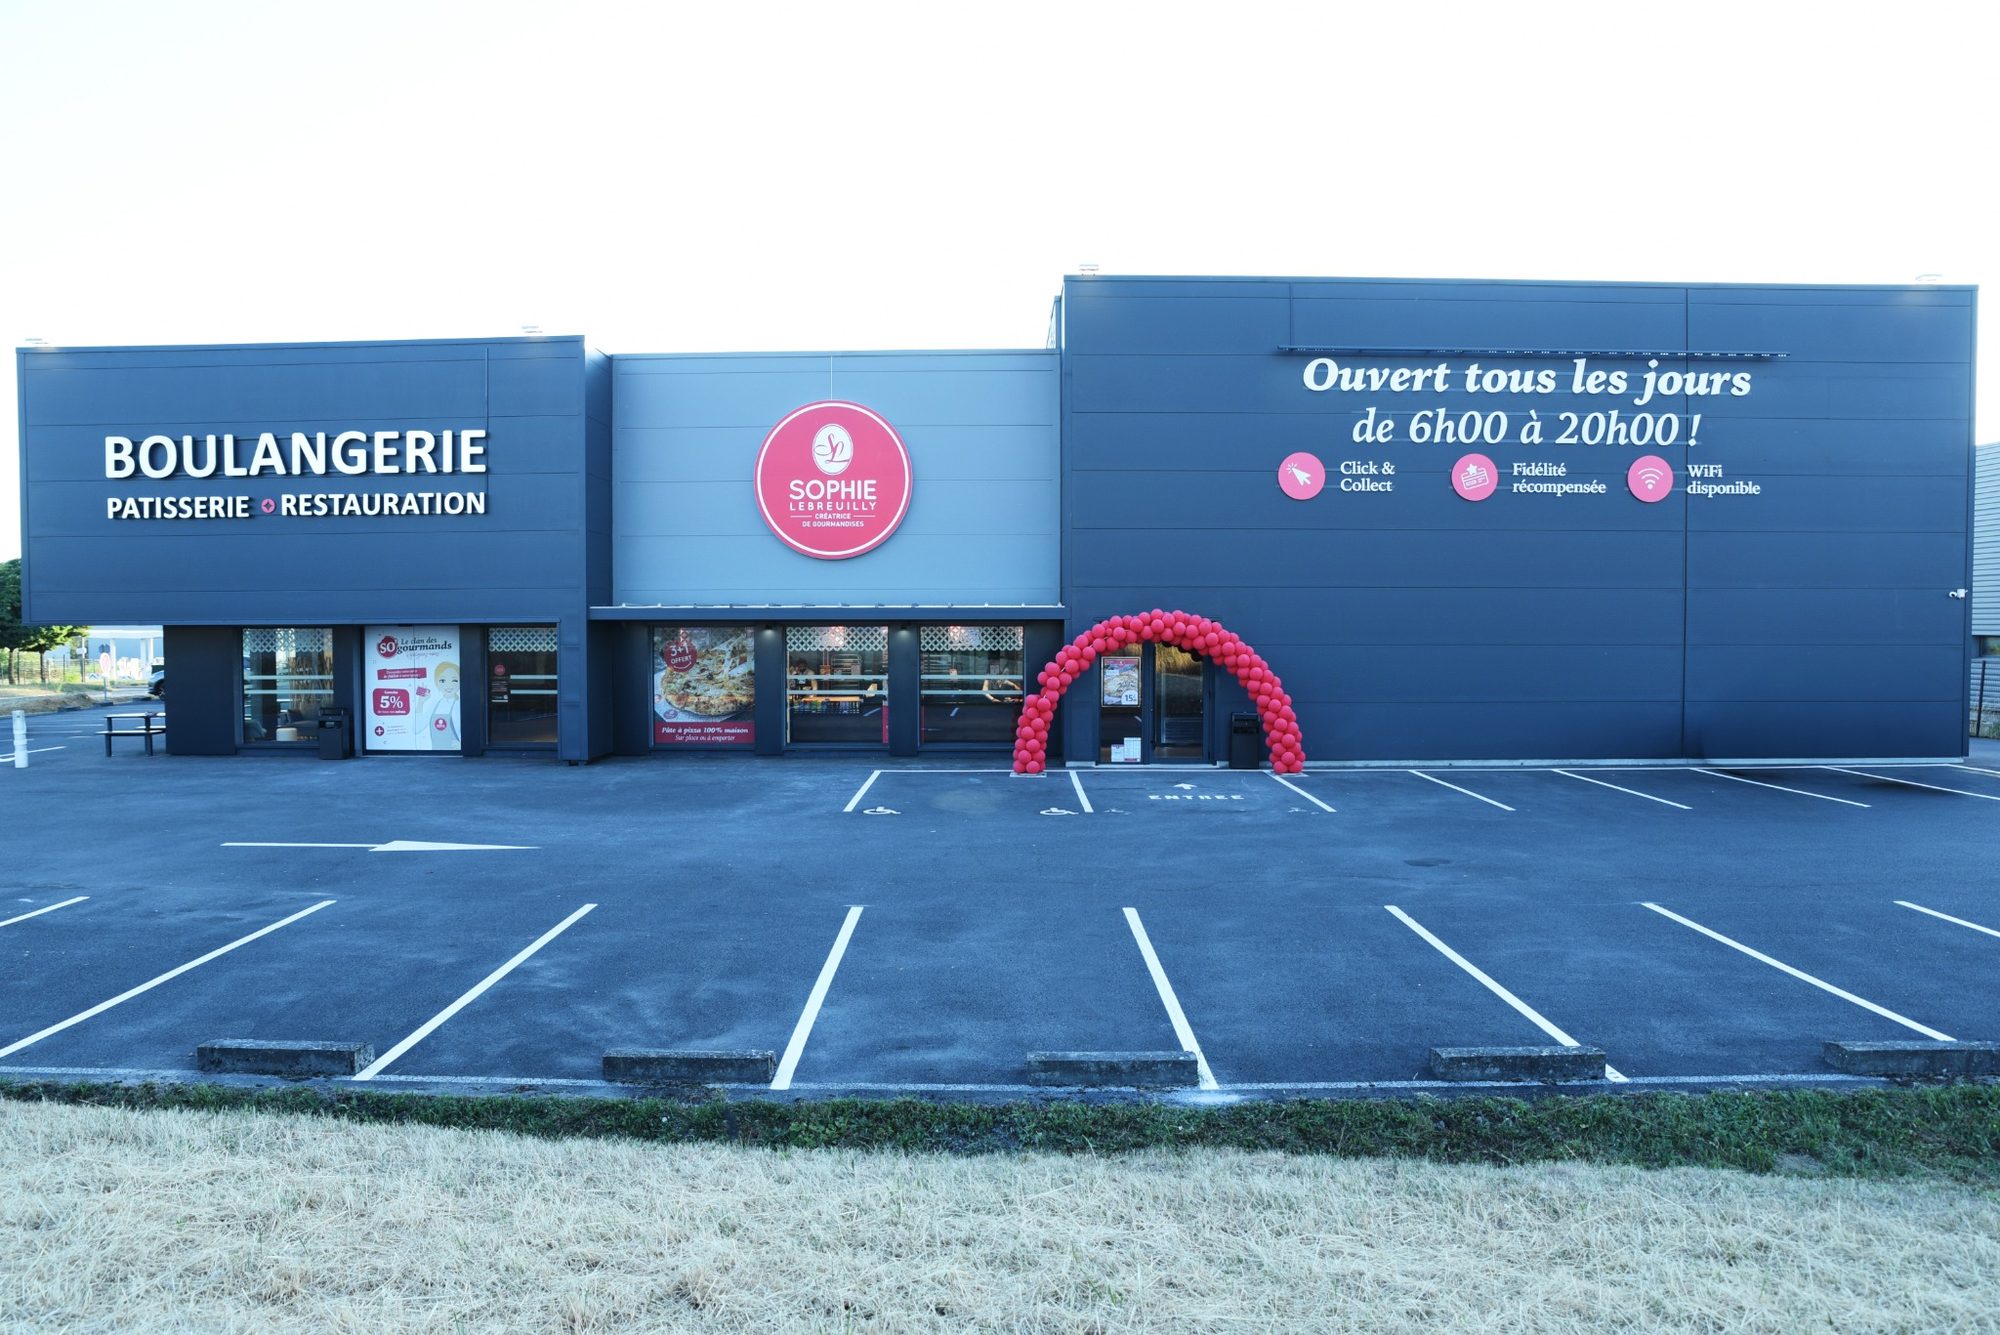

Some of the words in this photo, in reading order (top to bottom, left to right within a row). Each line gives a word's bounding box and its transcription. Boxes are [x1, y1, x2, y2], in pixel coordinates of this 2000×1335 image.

[1303, 357, 1450, 392] Ouvert
[1465, 363, 1556, 393] tous
[1572, 358, 1628, 394] les
[1634, 359, 1751, 406] jours
[1352, 407, 1394, 443] de
[1409, 408, 1508, 444] 6h00
[1520, 409, 1543, 445] à
[1555, 410, 1679, 446] 20h00
[1688, 414, 1701, 447] !
[105, 430, 486, 479] BOULANGERIE
[1340, 461, 1377, 475] Click
[1381, 462, 1396, 475] &
[1512, 462, 1566, 477] Fidélité
[1687, 464, 1723, 478] WiFi
[789, 479, 877, 500] SOPHIE
[1340, 478, 1392, 492] Collect
[1512, 479, 1606, 496] récompensée
[1687, 481, 1760, 497] disponible
[107, 495, 250, 519] PATISSERIE
[281, 492, 486, 516] RESTAURATION
[789, 501, 876, 511] LEBREUILLY
[815, 512, 852, 520] CRÉATRICE
[380, 641, 396, 654] SO
[396, 641, 452, 654] gourmands
[670, 643, 689, 656] 3+1
[670, 655, 692, 664] OFFERT
[380, 695, 403, 709] 5%
[683, 727, 701, 735] pizza
